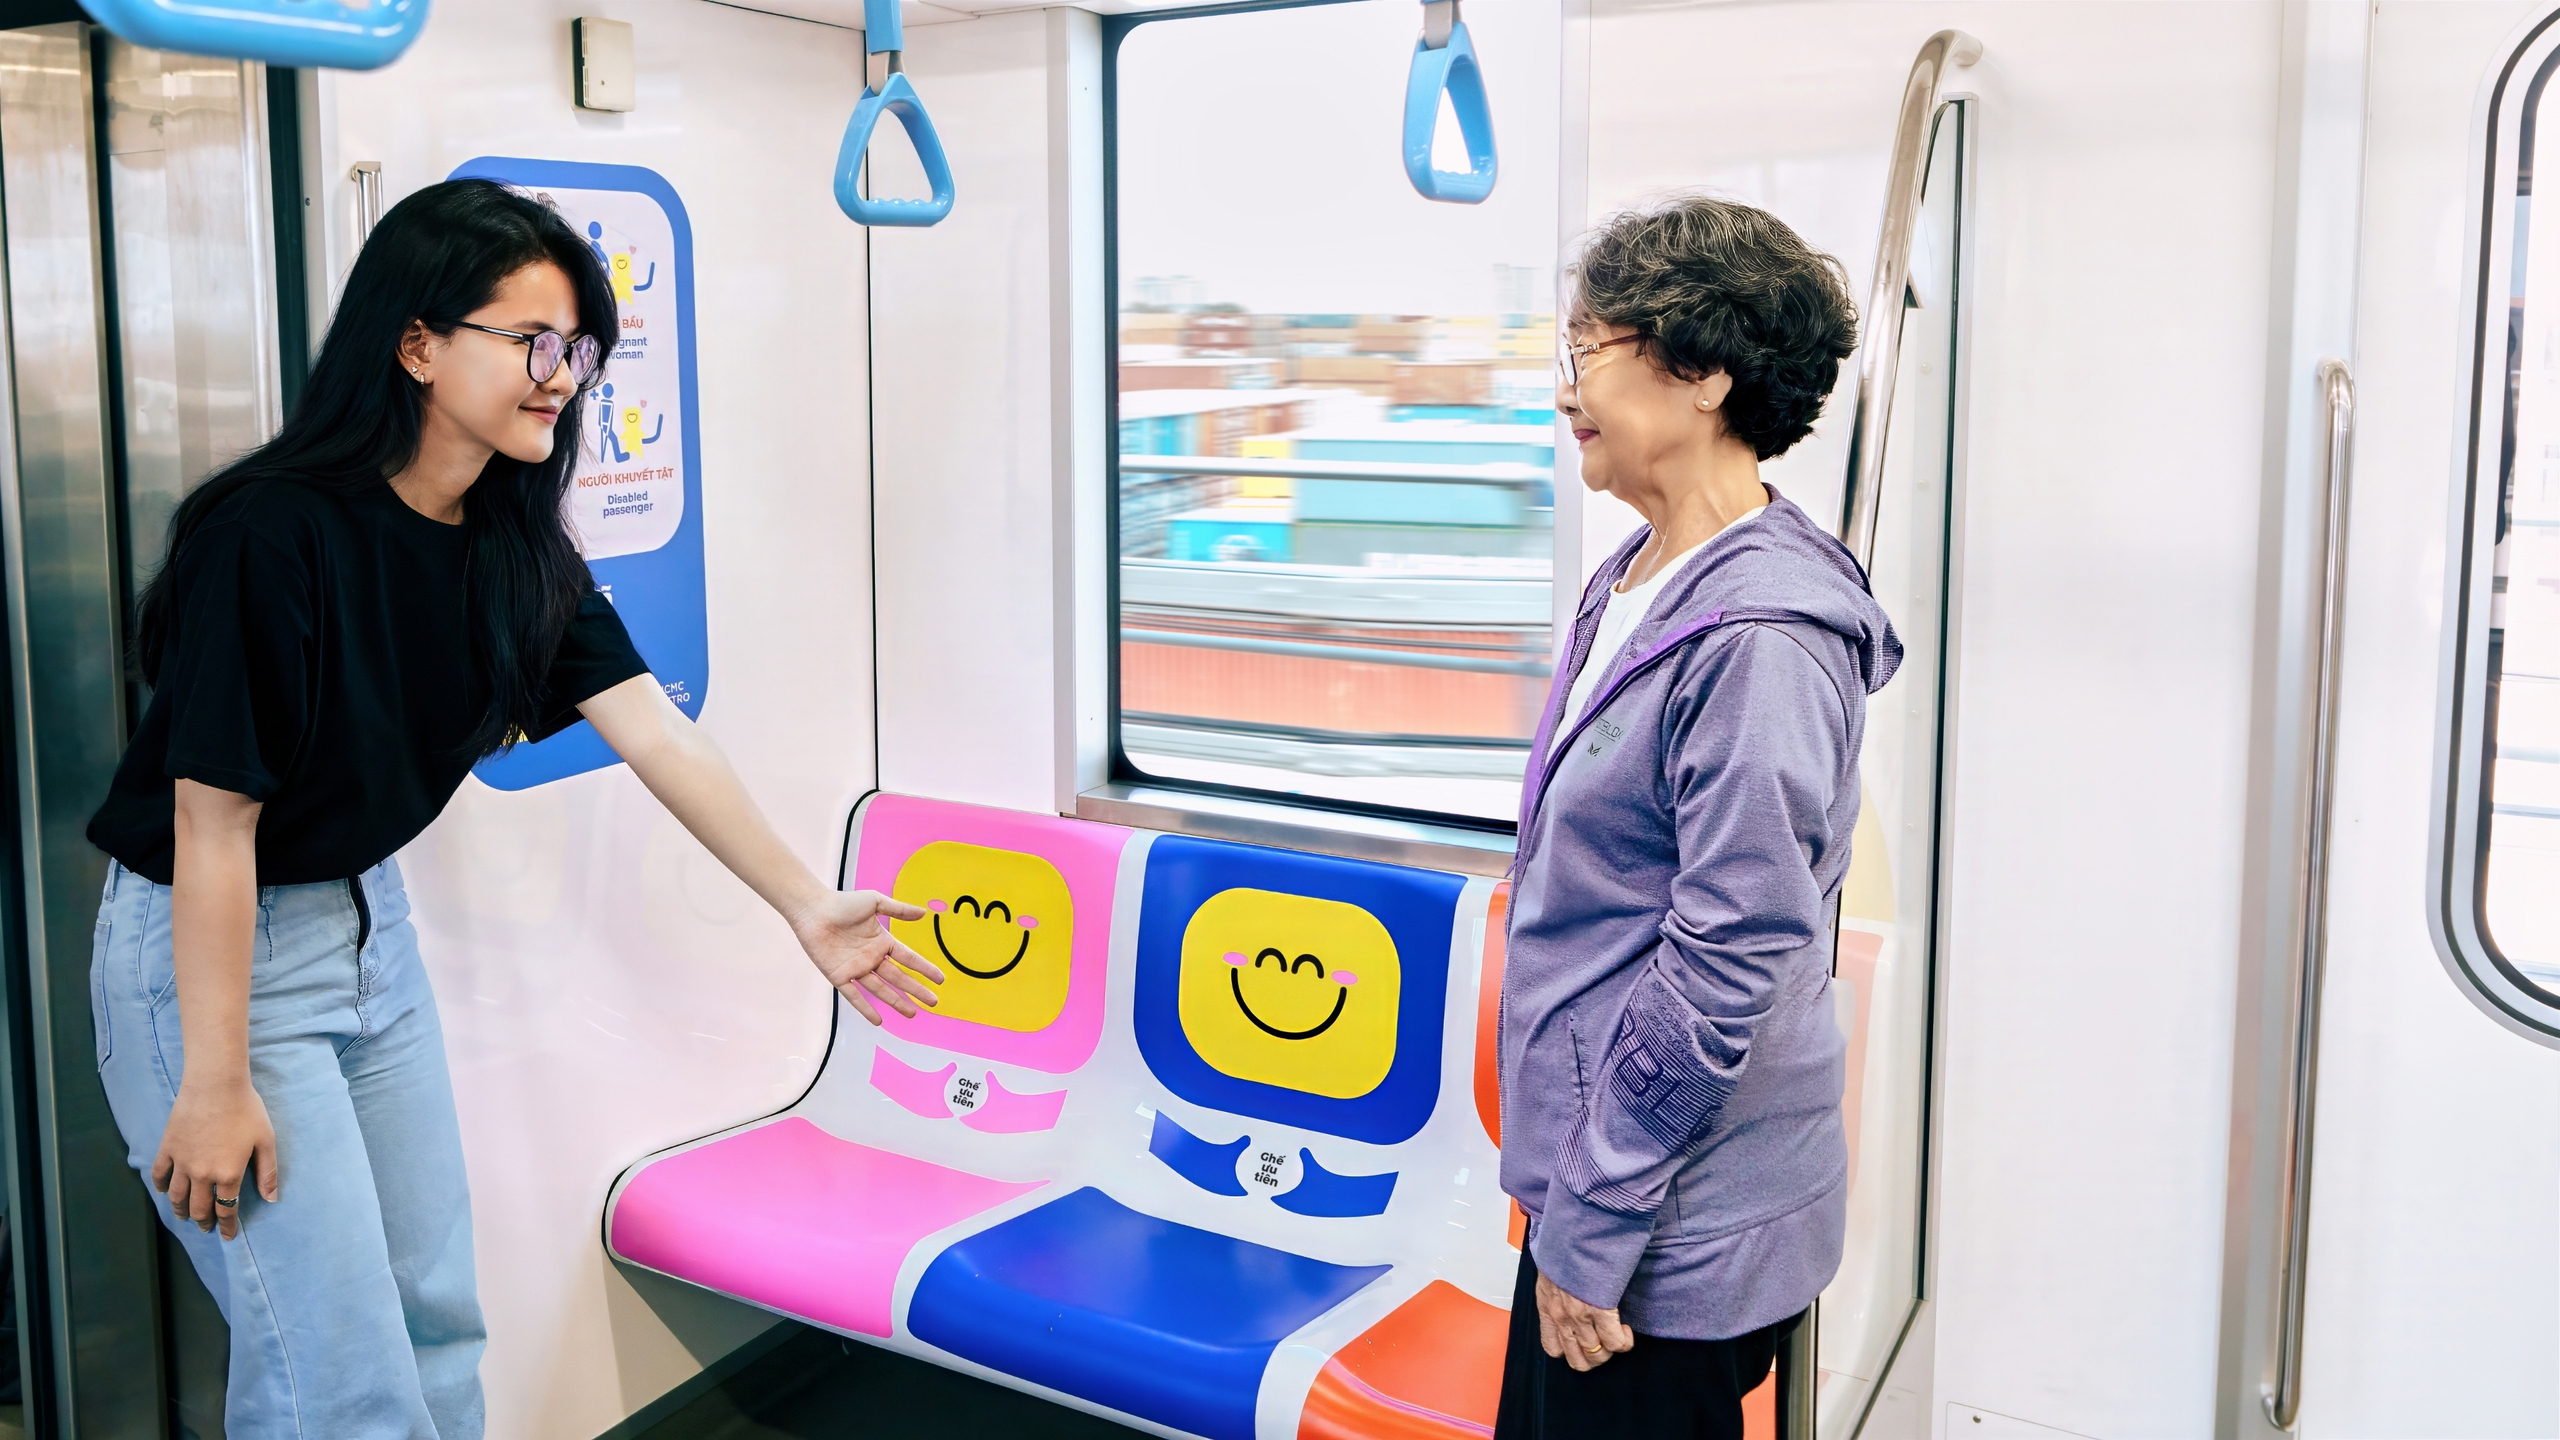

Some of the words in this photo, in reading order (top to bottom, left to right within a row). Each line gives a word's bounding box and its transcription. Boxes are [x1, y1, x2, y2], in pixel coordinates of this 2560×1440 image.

[618, 336, 648, 350] gnant
[607, 490, 648, 505] Disabled
[603, 502, 654, 519] passenger
[660, 680, 685, 695] CMC
[668, 691, 691, 705] TRO
[958, 1077, 982, 1091] Ghế
[959, 1088, 974, 1099] ưu
[952, 1094, 974, 1109] tiên
[1260, 1151, 1287, 1166] Ghế
[1261, 1163, 1278, 1175] ưu
[1254, 1171, 1279, 1188] tiên
